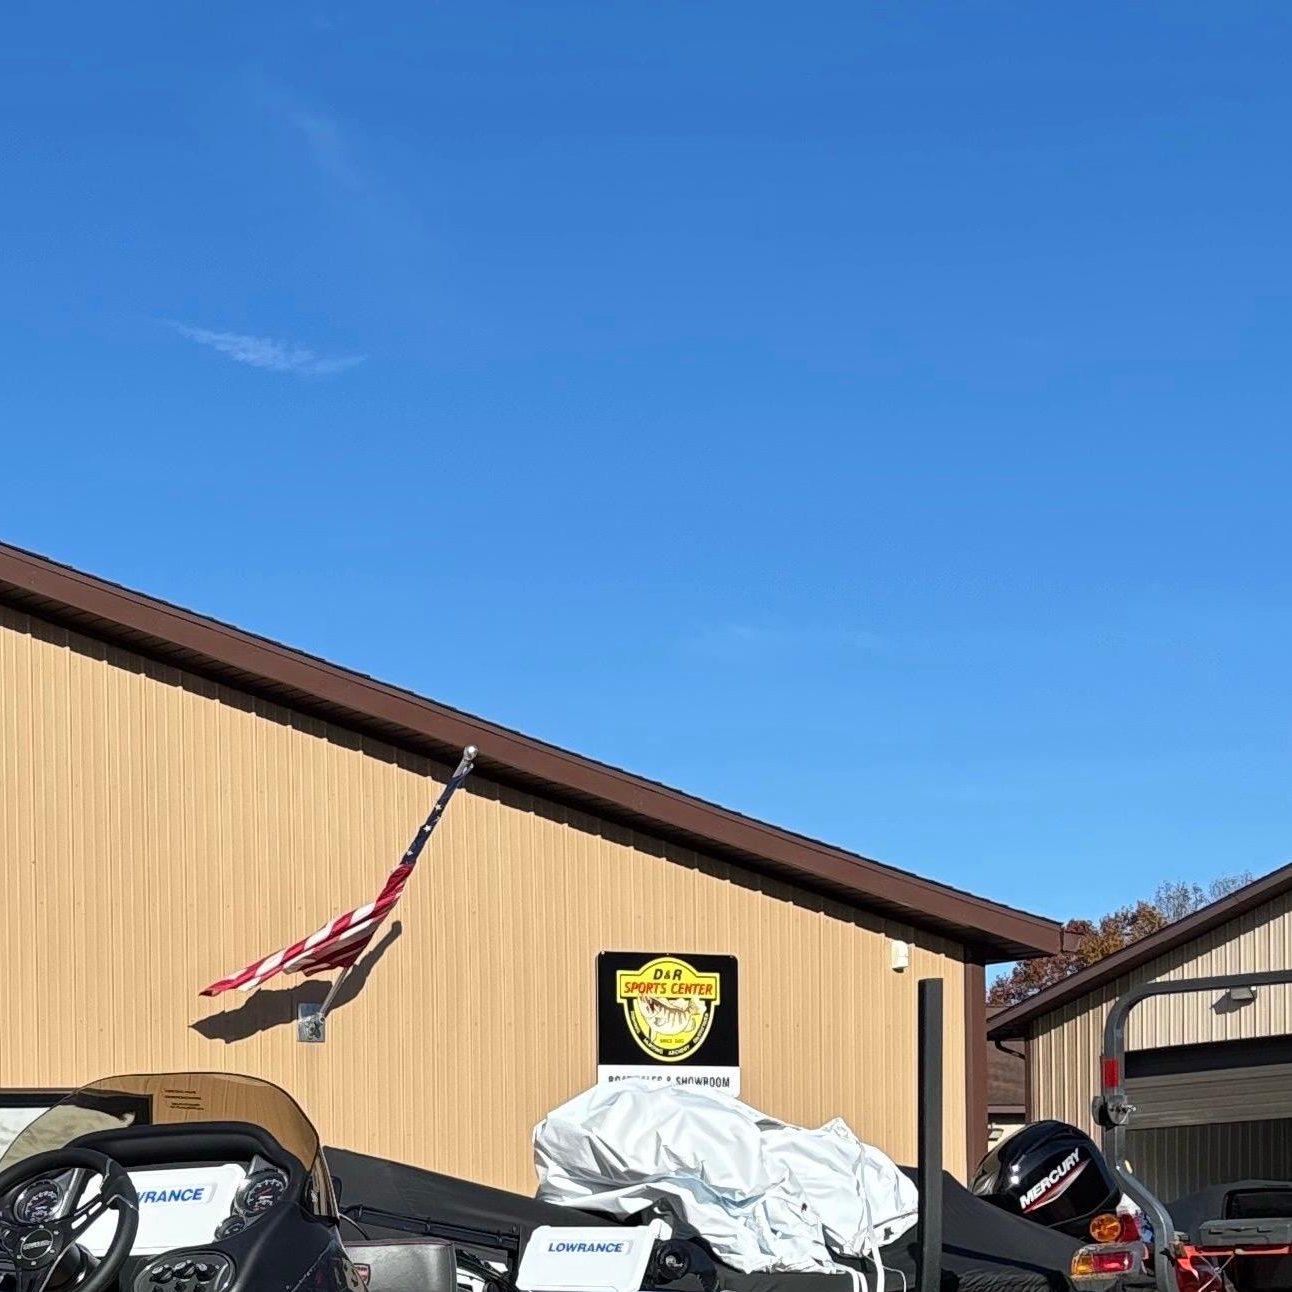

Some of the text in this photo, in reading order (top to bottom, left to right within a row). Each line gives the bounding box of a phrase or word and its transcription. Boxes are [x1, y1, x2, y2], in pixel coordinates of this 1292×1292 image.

[653, 968, 683, 981] D&R
[624, 981, 713, 996] SPORTS CENTER
[1019, 1148, 1080, 1209] MERCURY
[548, 1242, 624, 1253] LOWRANCE
